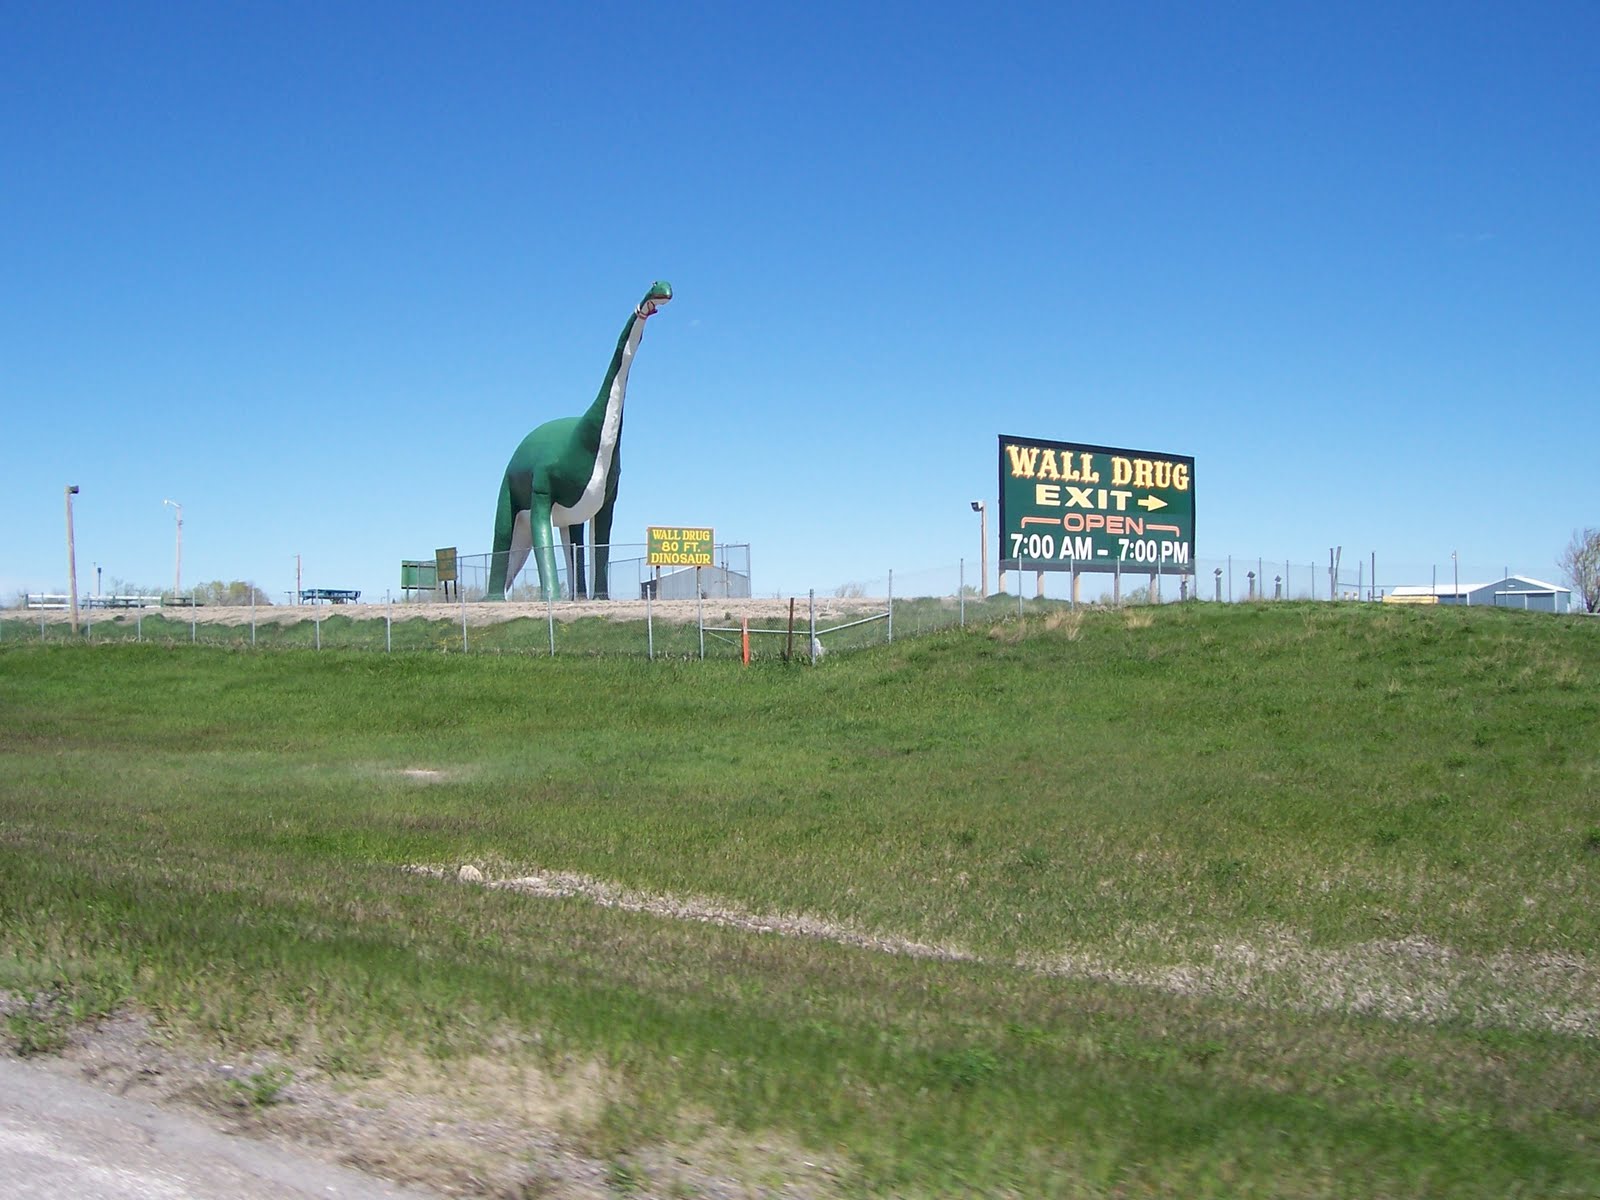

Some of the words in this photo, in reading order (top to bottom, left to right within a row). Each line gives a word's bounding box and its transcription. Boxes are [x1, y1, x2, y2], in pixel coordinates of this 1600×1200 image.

[1006, 444, 1099, 483] WALL
[1111, 456, 1189, 490] DRUG
[1036, 484, 1132, 511] EXIT
[652, 529, 681, 540] WALL
[682, 530, 710, 541] DRUG
[1063, 513, 1143, 535] OPEN
[661, 541, 679, 552] 80
[684, 542, 701, 552] FT.
[1010, 533, 1054, 559] 7:00
[1059, 536, 1092, 560] AM
[1118, 538, 1157, 563] 7:00
[1161, 541, 1189, 564] PM
[651, 553, 711, 564] DINOSAUR
